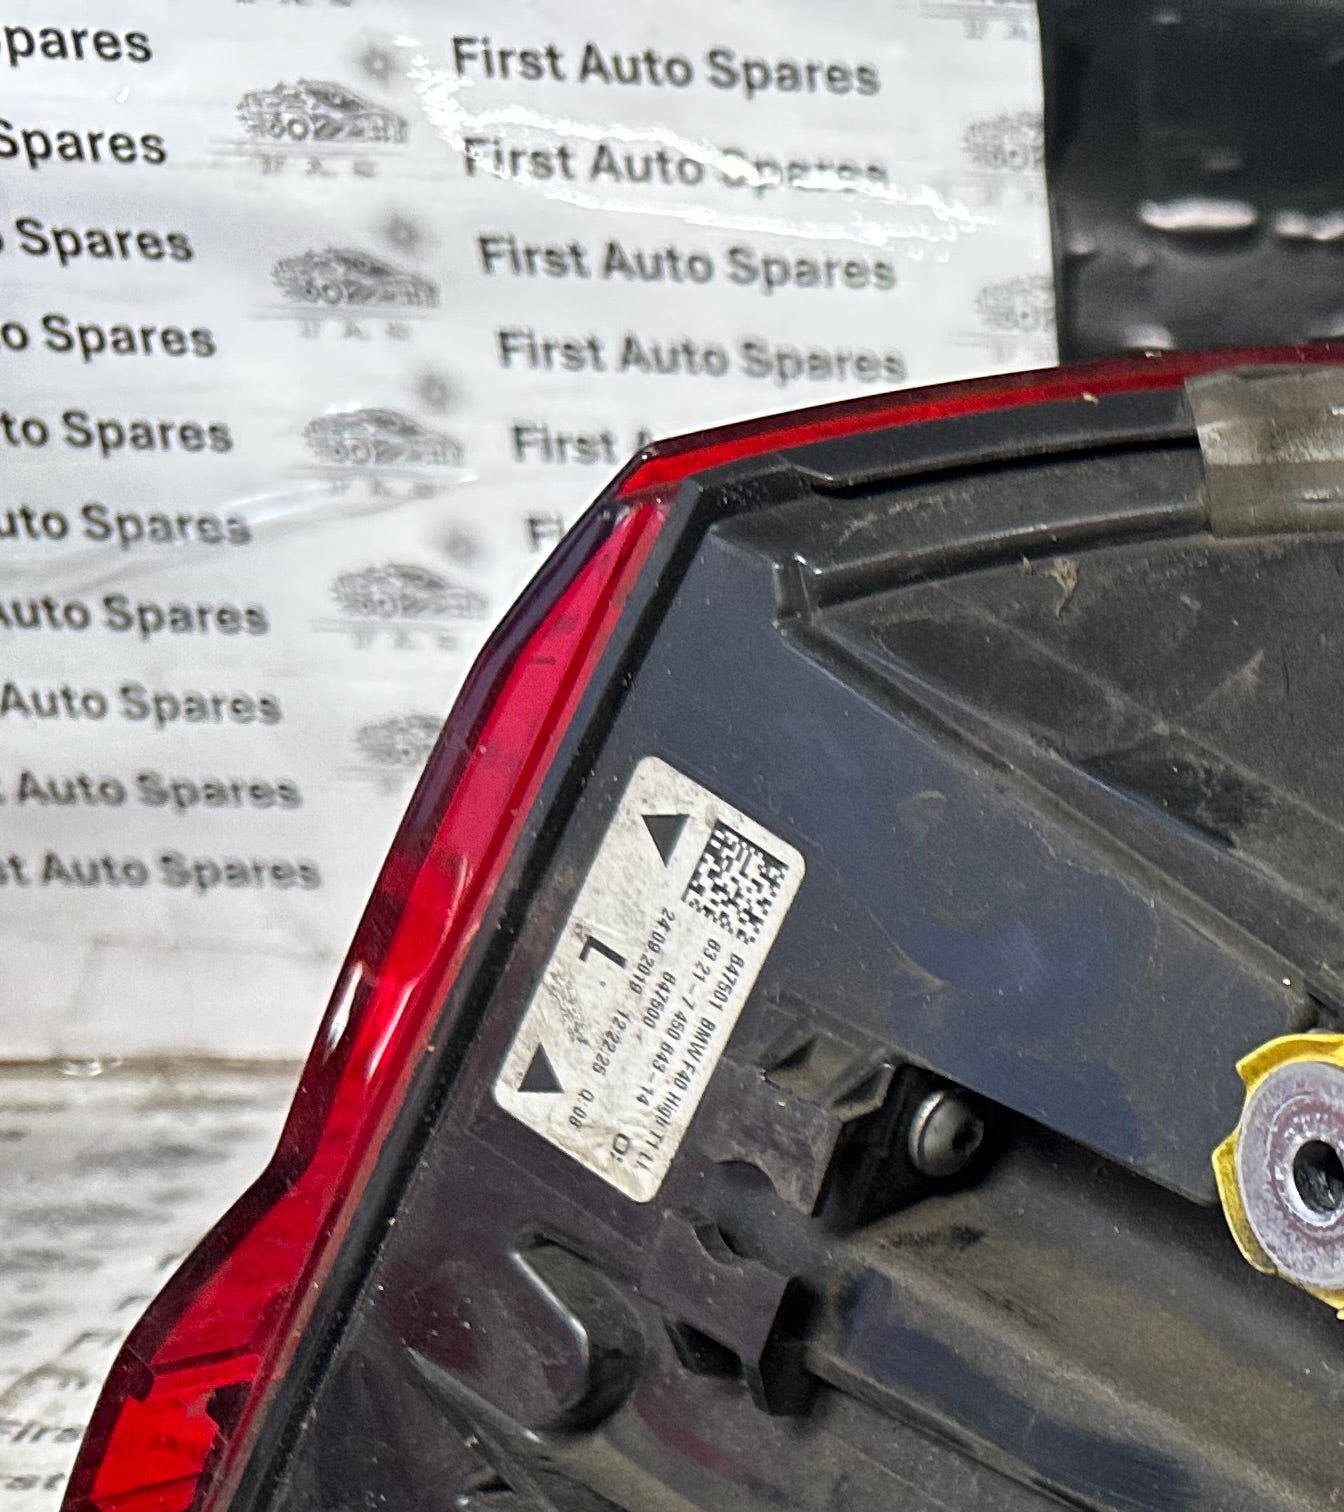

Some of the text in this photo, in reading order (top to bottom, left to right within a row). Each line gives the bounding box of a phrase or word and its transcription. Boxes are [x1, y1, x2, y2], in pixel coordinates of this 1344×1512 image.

[3, 26, 153, 68] pares
[451, 36, 881, 100] First Auto Spares
[463, 135, 574, 181] First
[589, 142, 706, 186] Auto
[15, 217, 194, 267] Spares
[476, 234, 897, 296] First Auto Spares
[41, 313, 217, 364] Spares
[496, 328, 907, 387] First Auto Spares
[61, 409, 233, 458] Spares
[509, 423, 616, 465] First
[80, 502, 253, 551] Spares
[102, 592, 269, 641] Spares
[0, 681, 283, 730] Auto Spares
[17, 769, 302, 815] Auto Spares
[40, 850, 149, 887] Auto
[156, 852, 322, 895] Spares
[576, 933, 627, 968] L
[684, 1016, 716, 1063] BMW
[672, 1059, 697, 1092] F40
[654, 1090, 682, 1130] High
